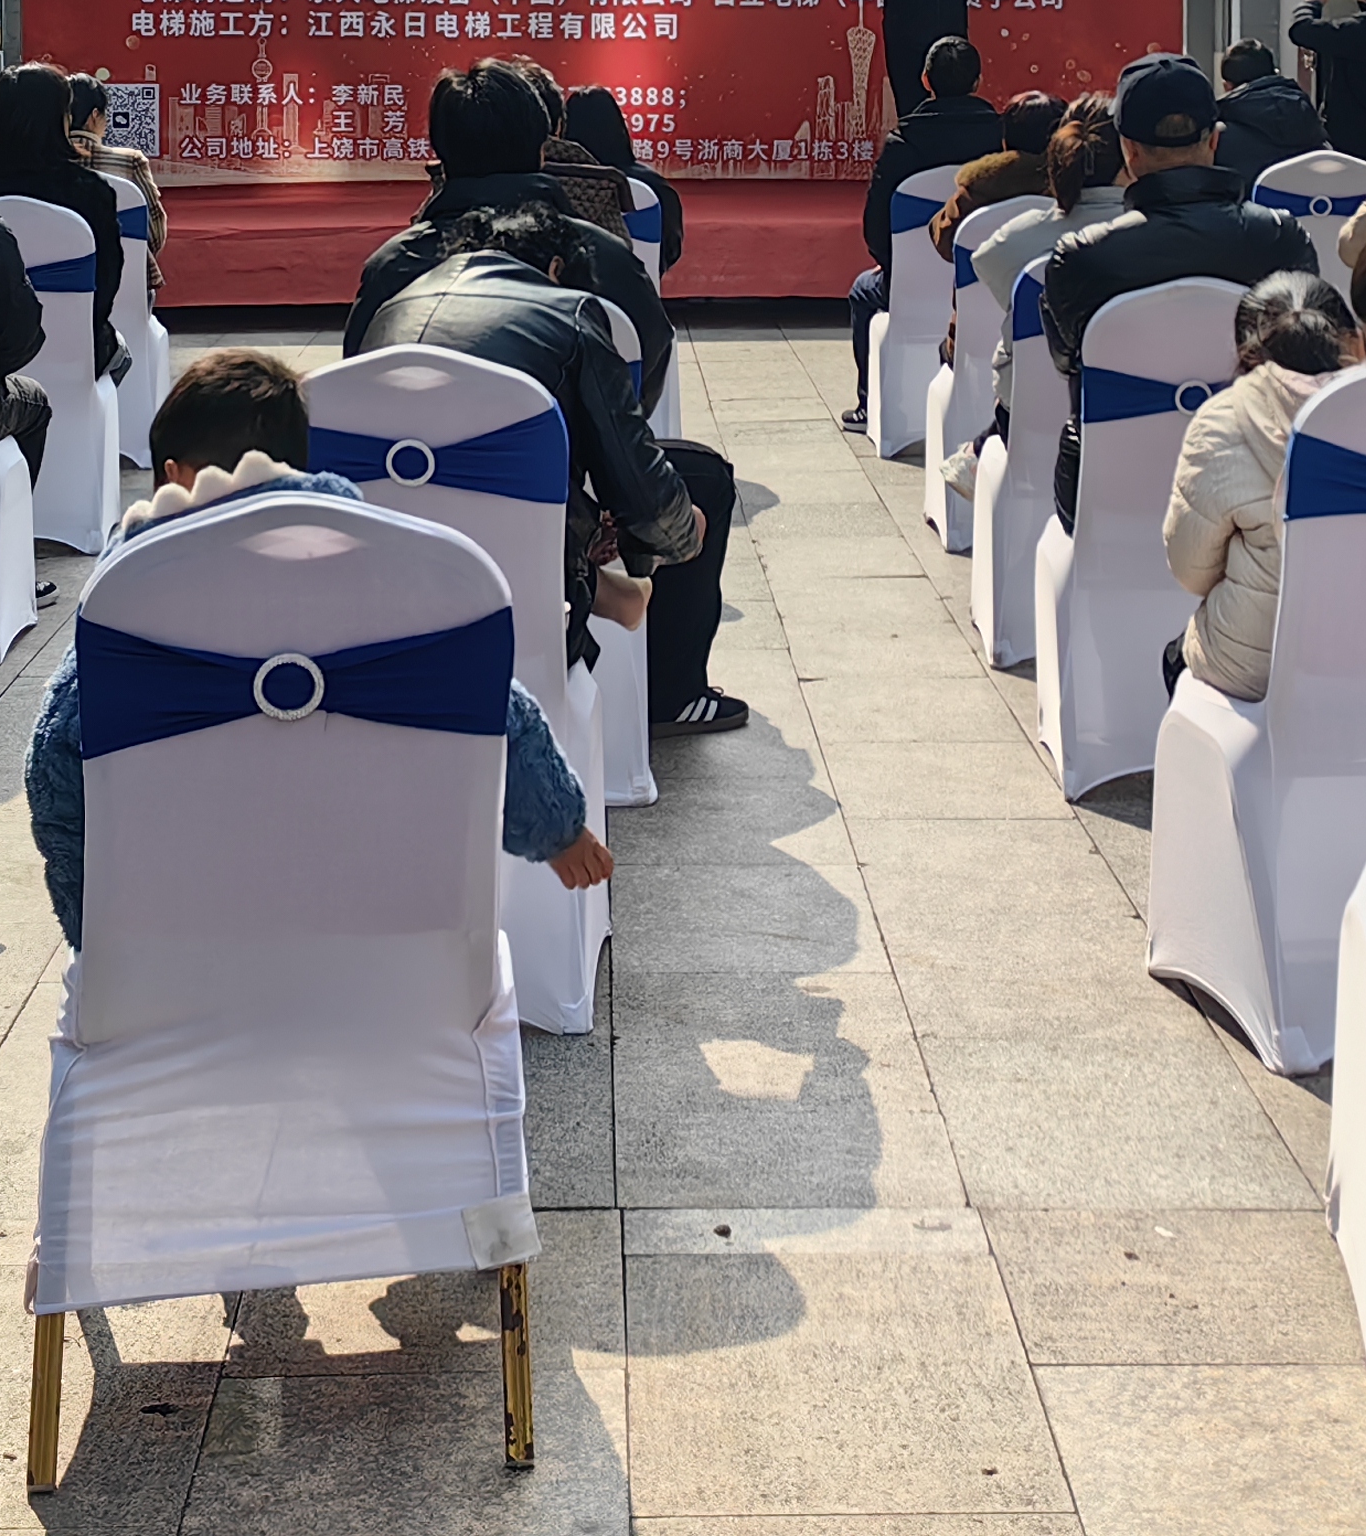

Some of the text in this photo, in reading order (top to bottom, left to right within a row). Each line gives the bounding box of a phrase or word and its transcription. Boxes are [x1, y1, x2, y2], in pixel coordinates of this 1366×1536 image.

[623, 112, 676, 133] 975
[180, 137, 432, 160] 公司地址：上饶市高铁
